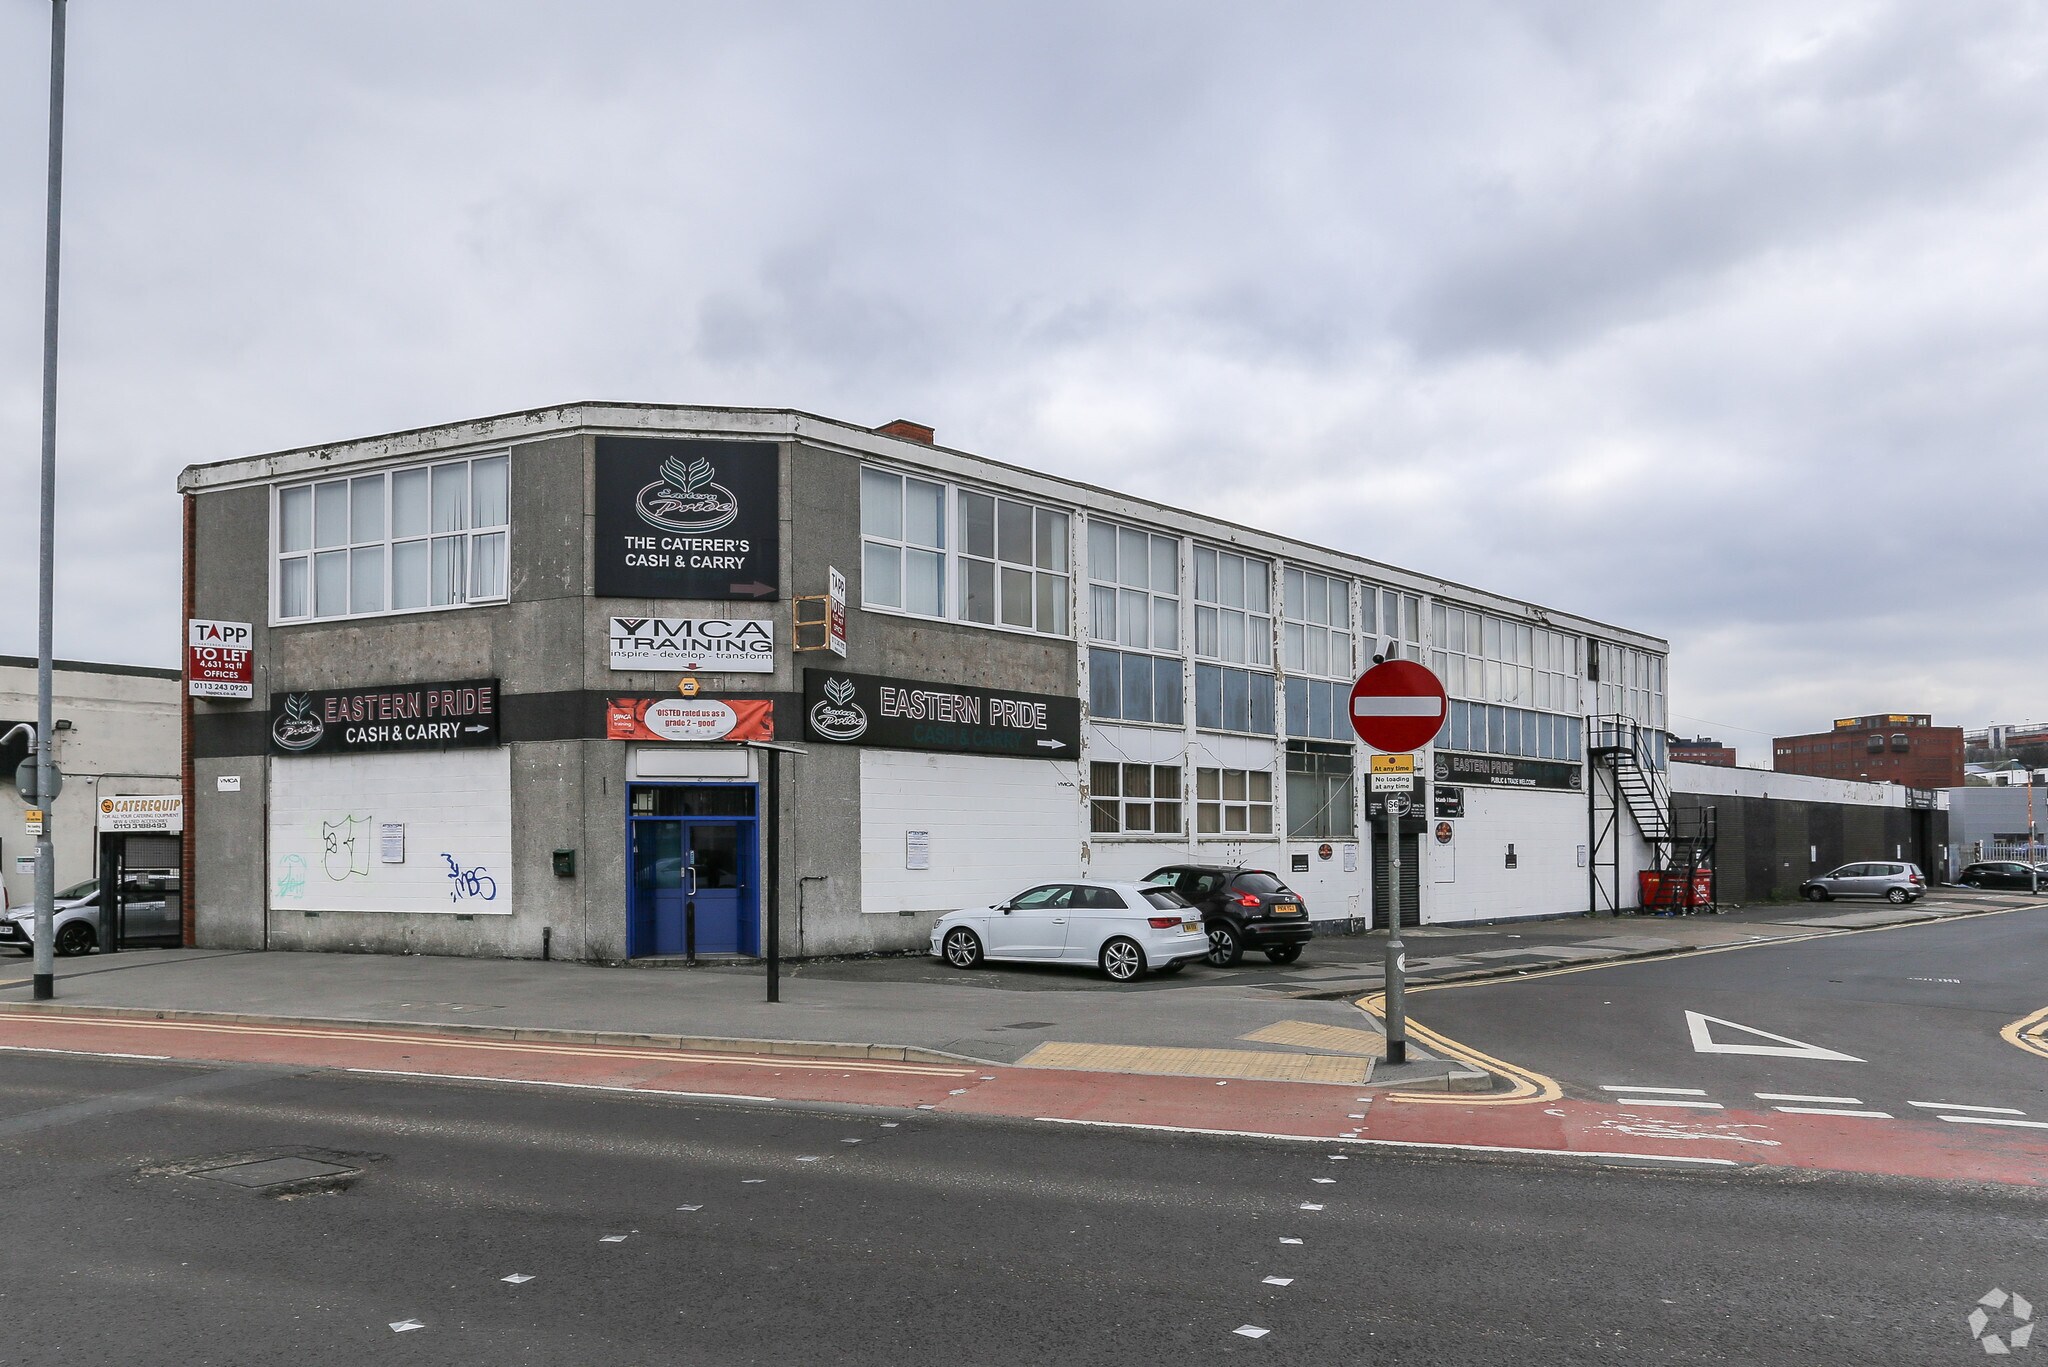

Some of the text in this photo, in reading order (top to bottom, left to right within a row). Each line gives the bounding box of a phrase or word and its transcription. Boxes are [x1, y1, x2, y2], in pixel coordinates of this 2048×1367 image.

[649, 499, 732, 516] Pride
[624, 536, 750, 553] THE CATERER'S
[625, 553, 746, 570] CASH & CARRY
[194, 623, 248, 643] TAPP
[613, 618, 771, 639] YMCA
[610, 637, 773, 653] TRAINING
[194, 647, 248, 662] TO LET
[611, 650, 649, 659] inspire
[660, 650, 706, 660] develop
[716, 651, 773, 660] transform
[203, 670, 239, 679] OFFICES
[224, 662, 235, 670] sq
[236, 662, 242, 670] ft
[194, 682, 248, 692] 0113 243 0920
[324, 687, 492, 723] EASTERN PRIDE
[682, 709, 701, 717] rated
[880, 686, 1047, 730] EASTERN PRIDE
[665, 719, 685, 727] grade
[686, 719, 691, 727] 2
[346, 722, 461, 743] CASH & CARRY
[913, 724, 955, 744] CASH
[973, 731, 1022, 748] CARRY
[1453, 757, 1490, 774] EASTERN
[1491, 760, 1514, 775] PRIDE
[114, 799, 181, 812] CATEREQUIP
